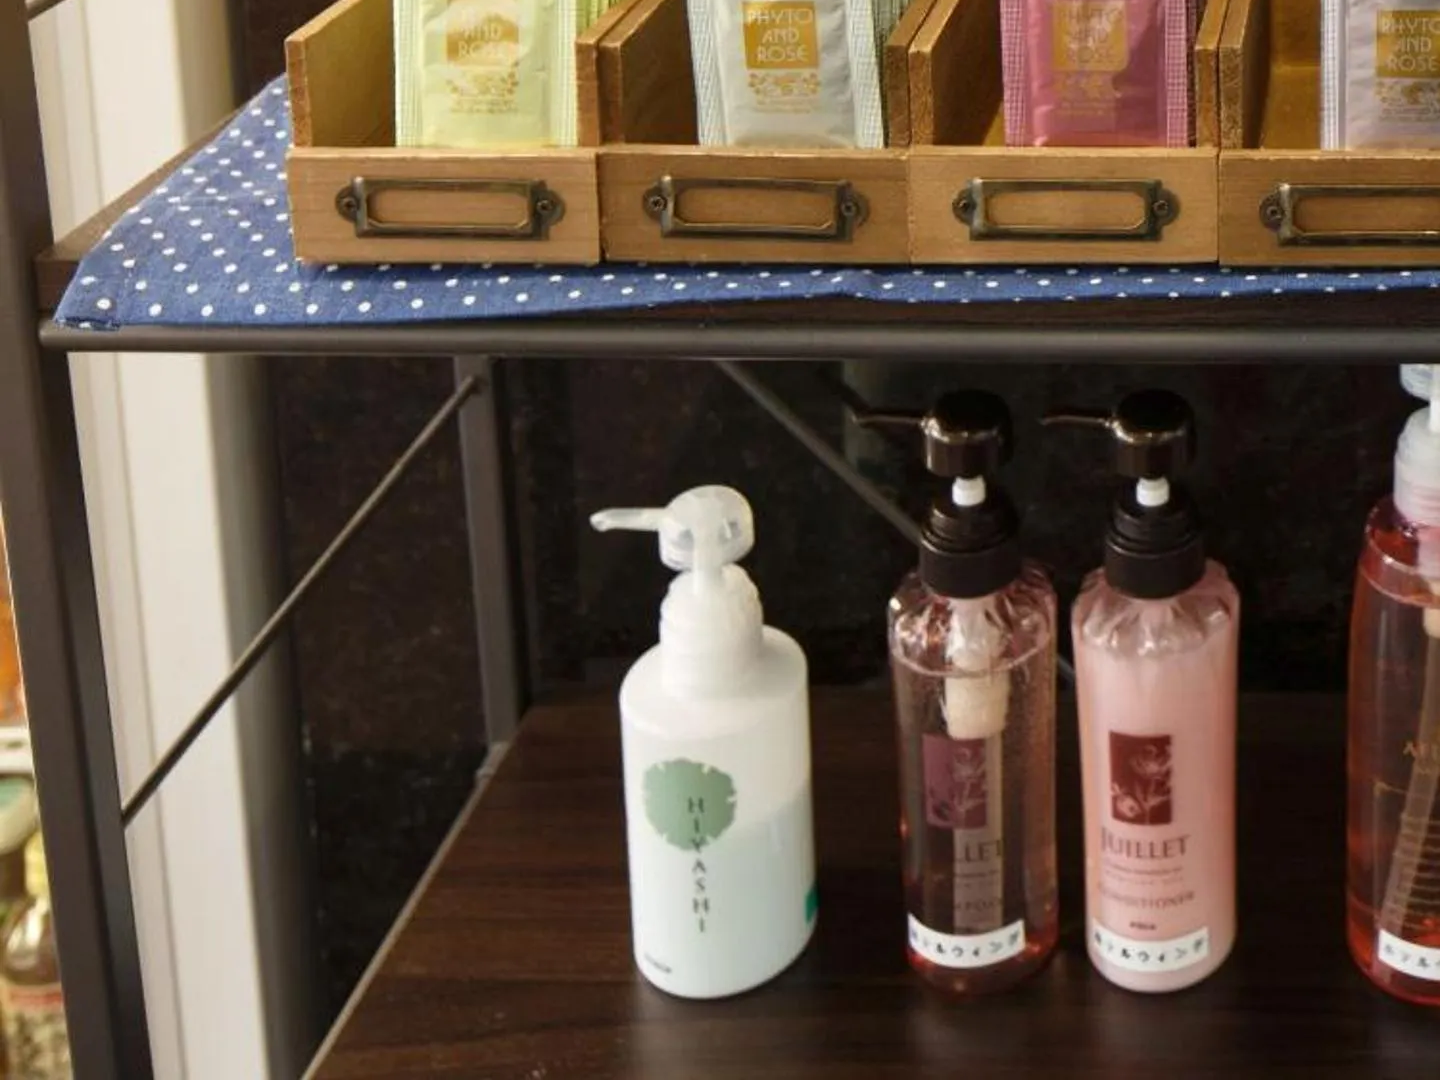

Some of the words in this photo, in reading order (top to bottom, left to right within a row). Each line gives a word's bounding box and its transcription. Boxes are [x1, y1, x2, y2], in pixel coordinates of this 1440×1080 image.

[747, 7, 814, 25] PHYTO
[761, 27, 800, 45] AND
[1396, 35, 1433, 53] AND
[756, 44, 809, 64] ROSE
[1386, 54, 1439, 72] ROSE
[1100, 825, 1192, 860] JUILLET
